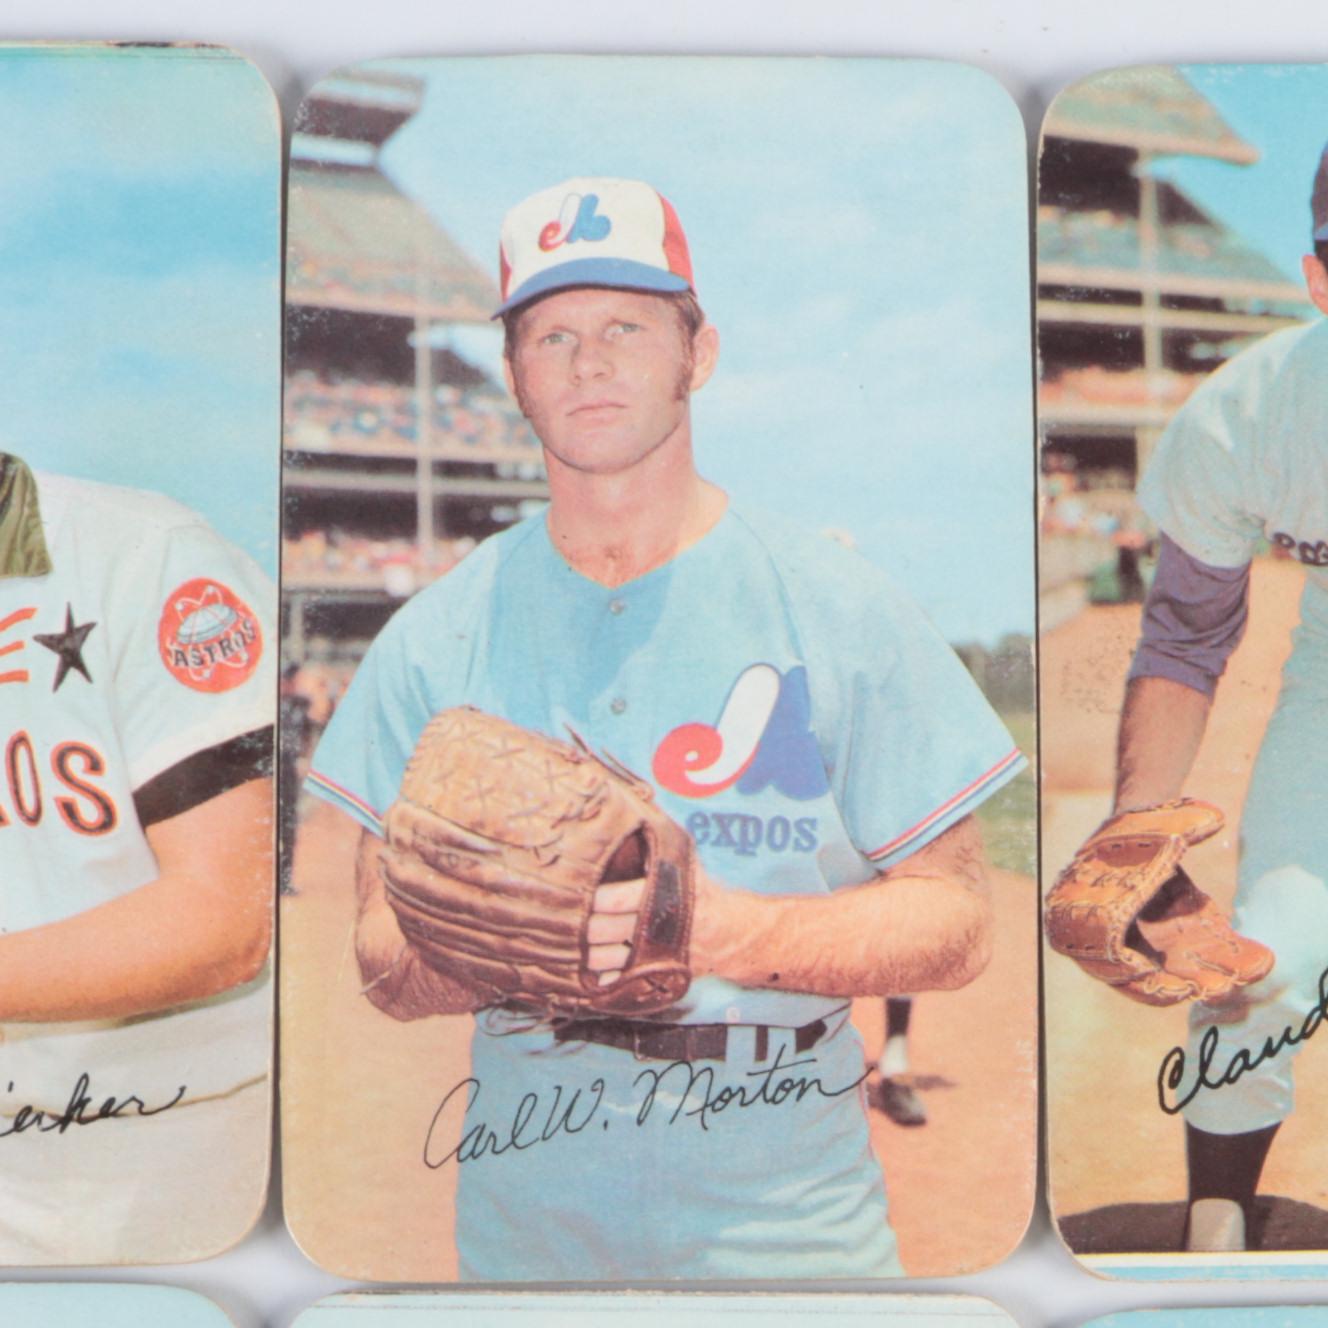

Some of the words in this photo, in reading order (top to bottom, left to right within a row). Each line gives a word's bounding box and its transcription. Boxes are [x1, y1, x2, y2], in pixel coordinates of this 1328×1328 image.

[173, 619, 256, 667] ASTROS
[0, 729, 117, 837] OS
[686, 811, 818, 857] expos
[423, 1078, 542, 1170] Carl
[632, 1043, 876, 1131] Morton
